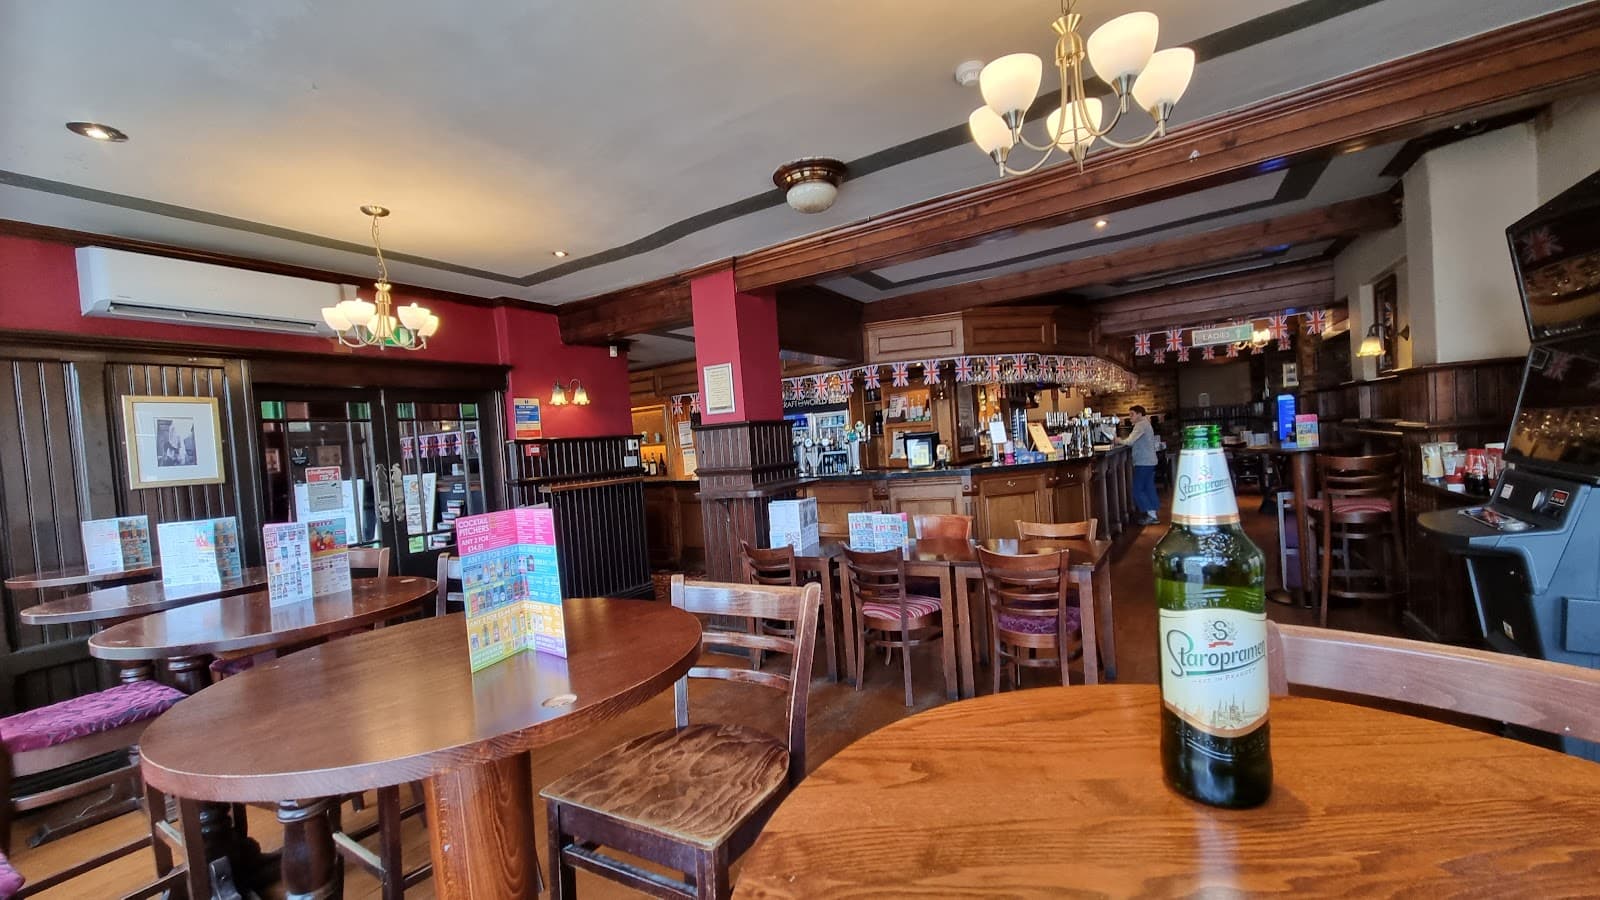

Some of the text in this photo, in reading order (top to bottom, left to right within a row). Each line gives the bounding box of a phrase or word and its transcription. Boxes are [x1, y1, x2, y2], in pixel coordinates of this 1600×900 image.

[458, 517, 488, 529] COCKTAIL
[459, 525, 490, 537] PITCHERS
[1212, 620, 1228, 641] S
